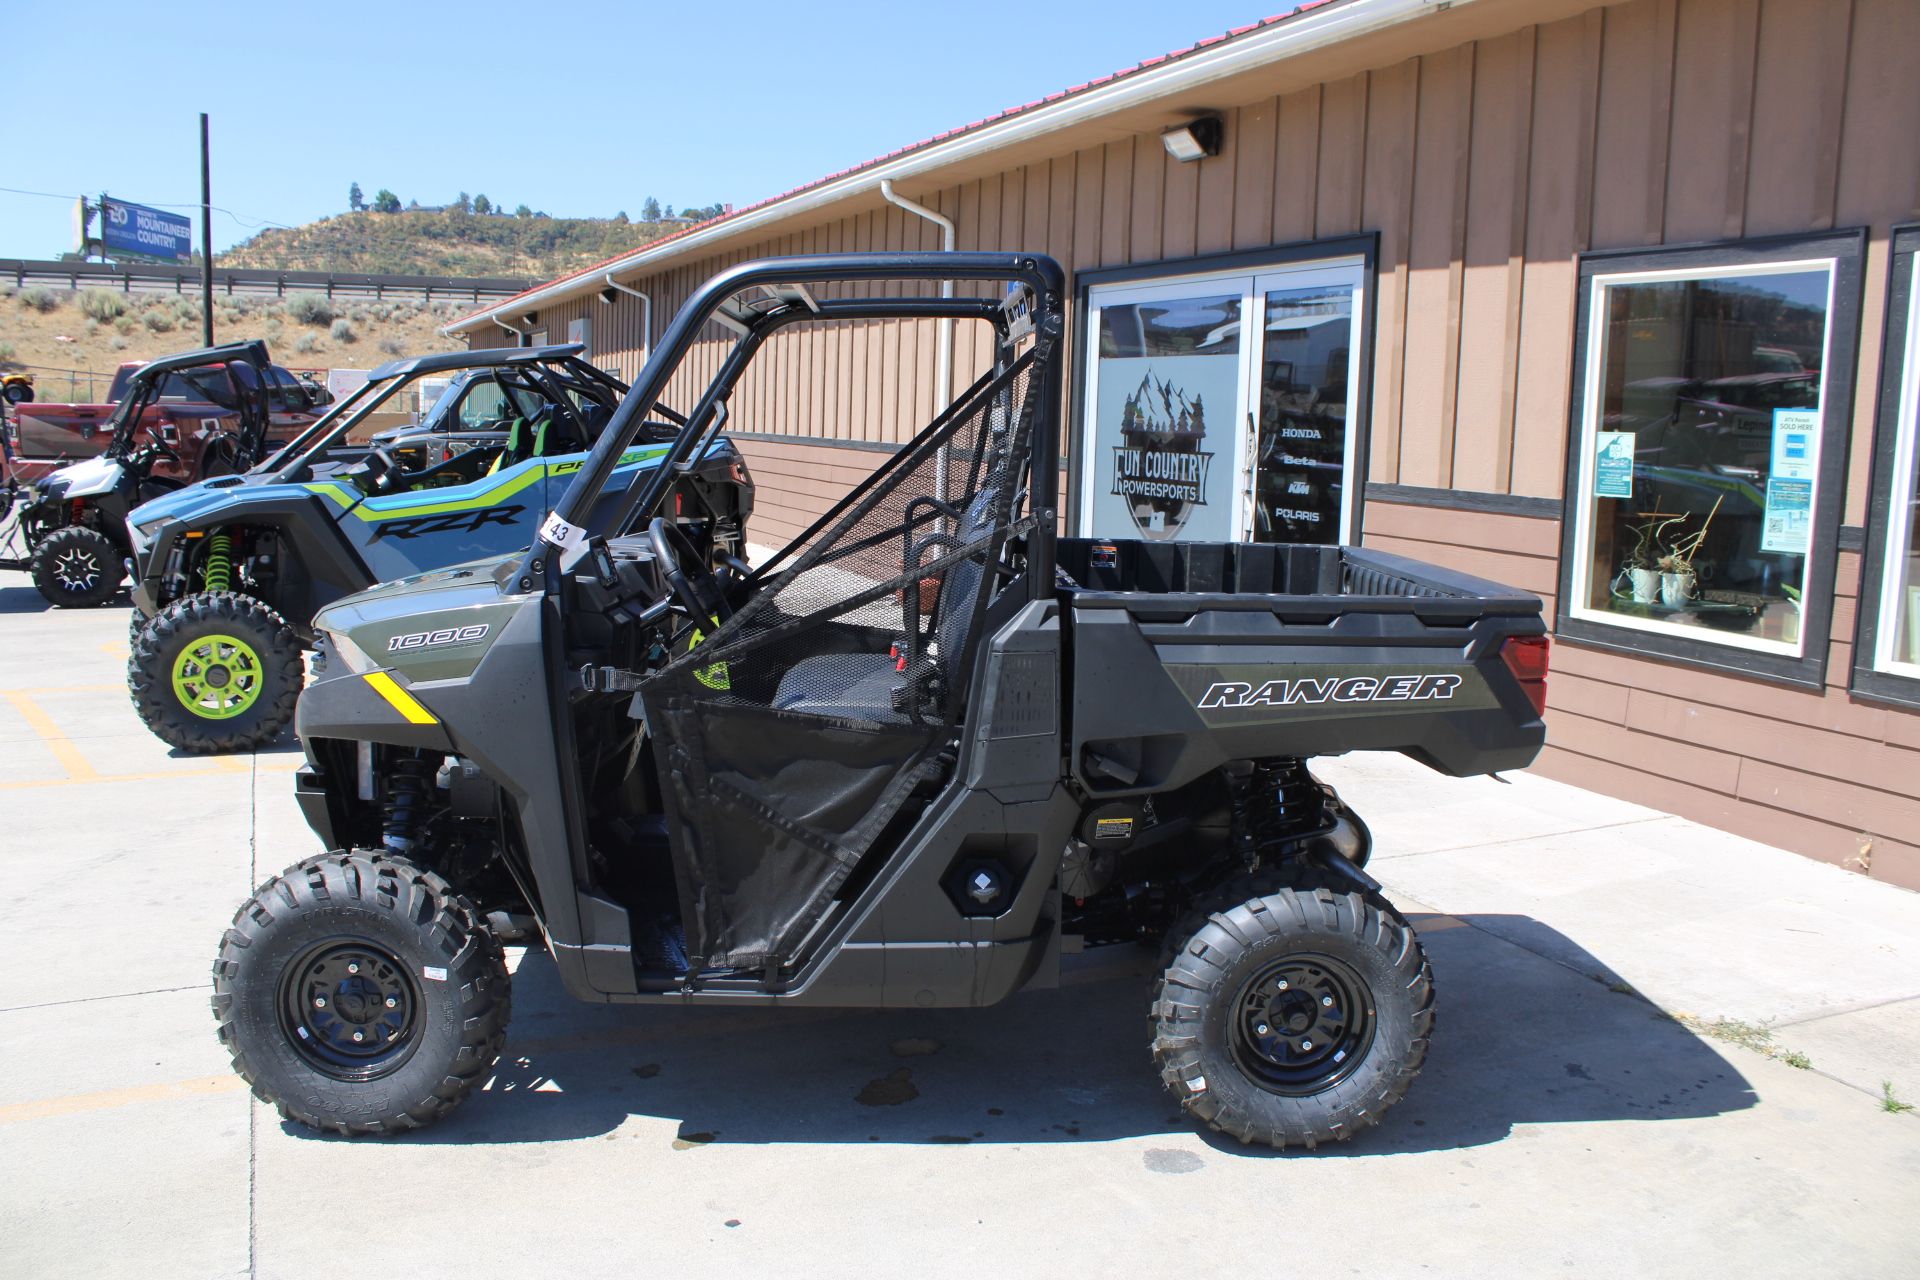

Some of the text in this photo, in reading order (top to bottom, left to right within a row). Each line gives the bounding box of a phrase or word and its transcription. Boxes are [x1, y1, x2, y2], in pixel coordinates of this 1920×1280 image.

[137, 214, 191, 240] MOUNTAINEER
[137, 230, 176, 249] COUNTRY!
[1281, 428, 1322, 439] HONDA
[1797, 423, 1815, 431] HERE
[1283, 454, 1317, 466] Beta
[1113, 448, 1210, 503] FUN COUNTRY
[1122, 479, 1197, 501] POWERSPORTS
[1287, 481, 1310, 495] KTM
[1275, 507, 1320, 522] POLARIS
[365, 505, 526, 546] RZR
[388, 624, 490, 650] 1000
[1198, 675, 1462, 708] RANGER
